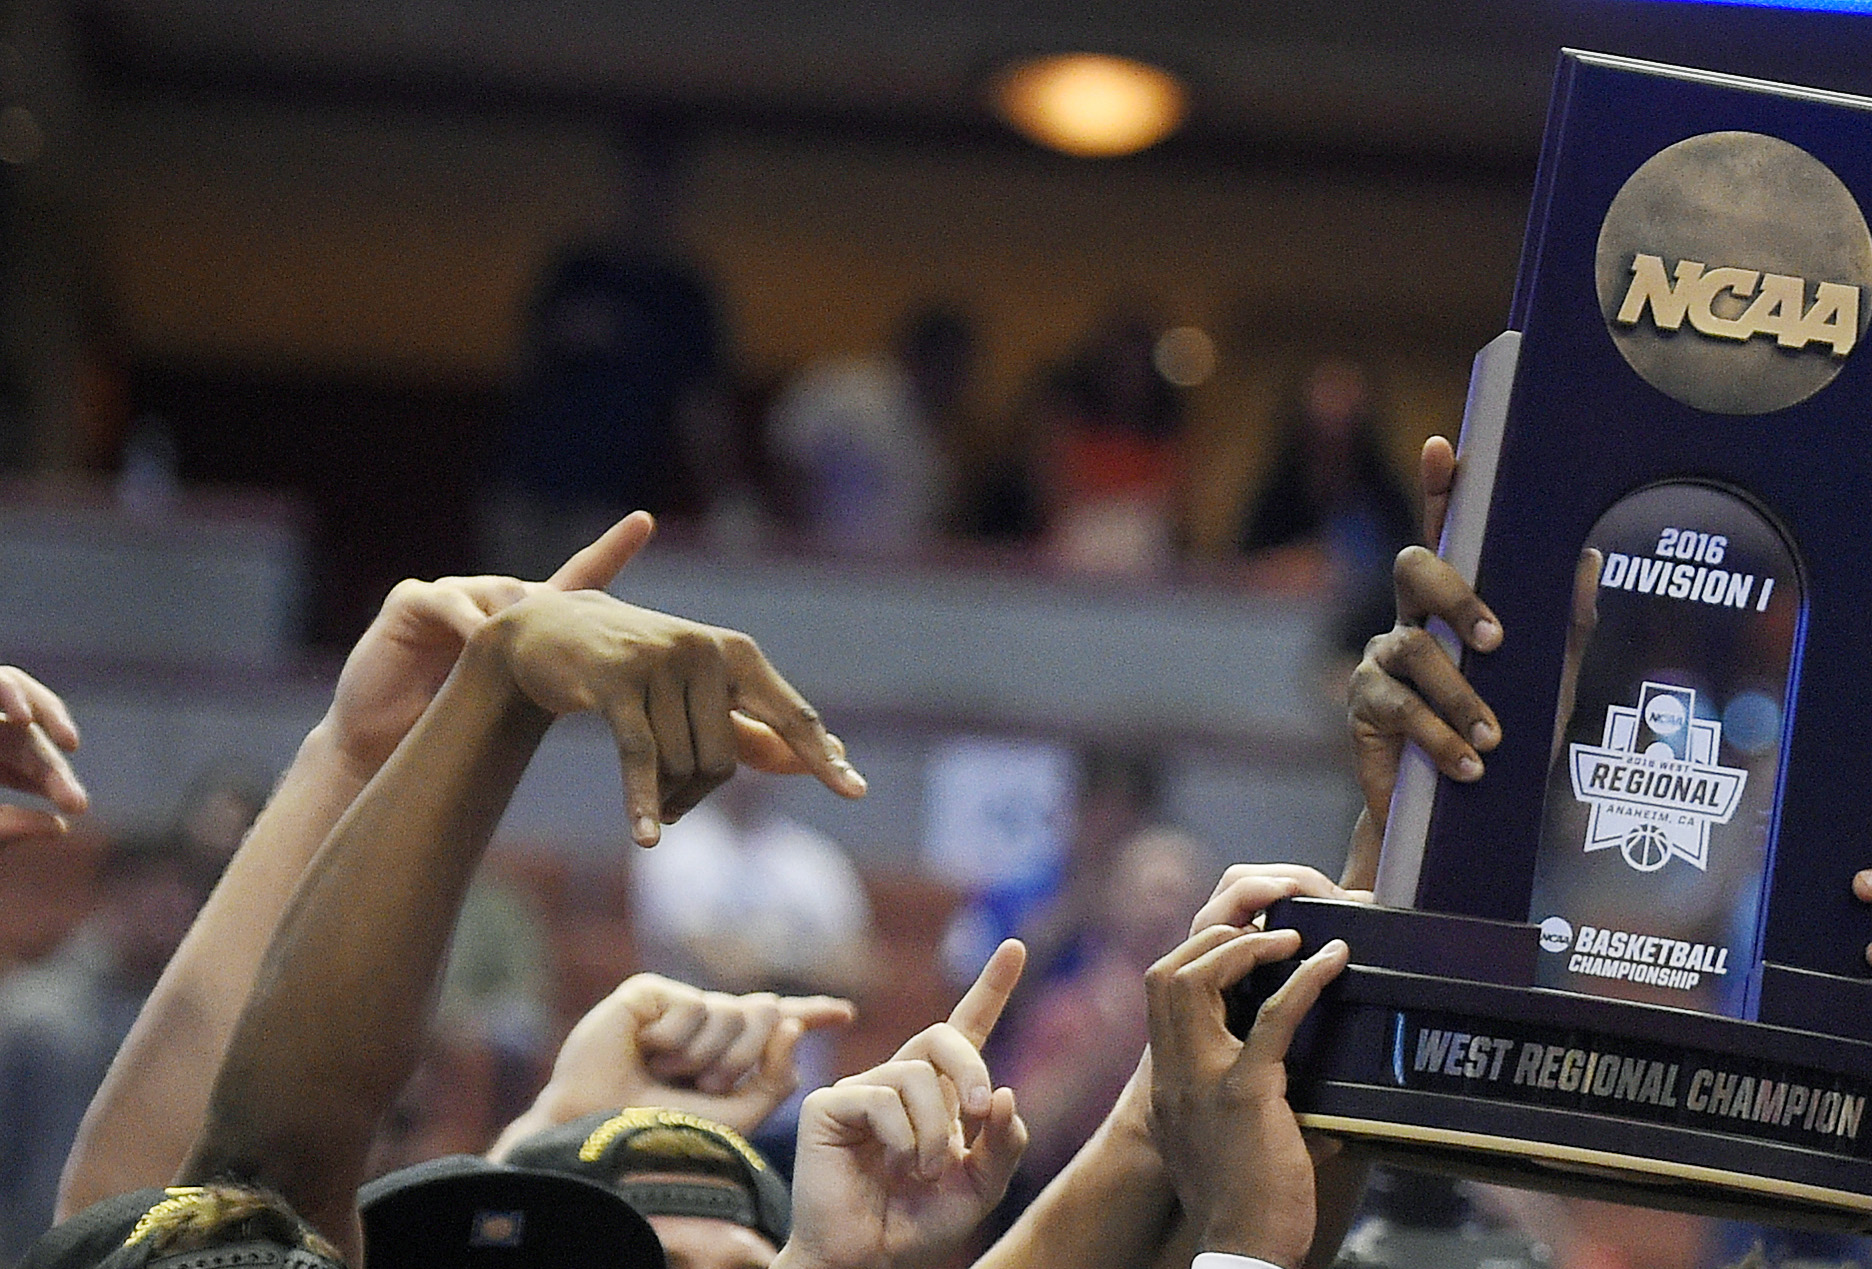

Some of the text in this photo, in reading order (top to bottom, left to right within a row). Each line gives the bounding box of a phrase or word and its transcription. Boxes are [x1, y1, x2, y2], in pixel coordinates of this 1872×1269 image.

[1617, 253, 1860, 356] NCAA
[1655, 527, 1728, 565] 2016
[1601, 552, 1775, 612] DIVISION I
[1589, 762, 1721, 808] REGIONAL
[1678, 814, 1696, 827] CA
[1567, 953, 1701, 991] CHAMPIONSHIP
[1574, 925, 1729, 975] BASKETBALL
[1413, 1028, 1866, 1139] WEST REGIONAL CHAMPION
